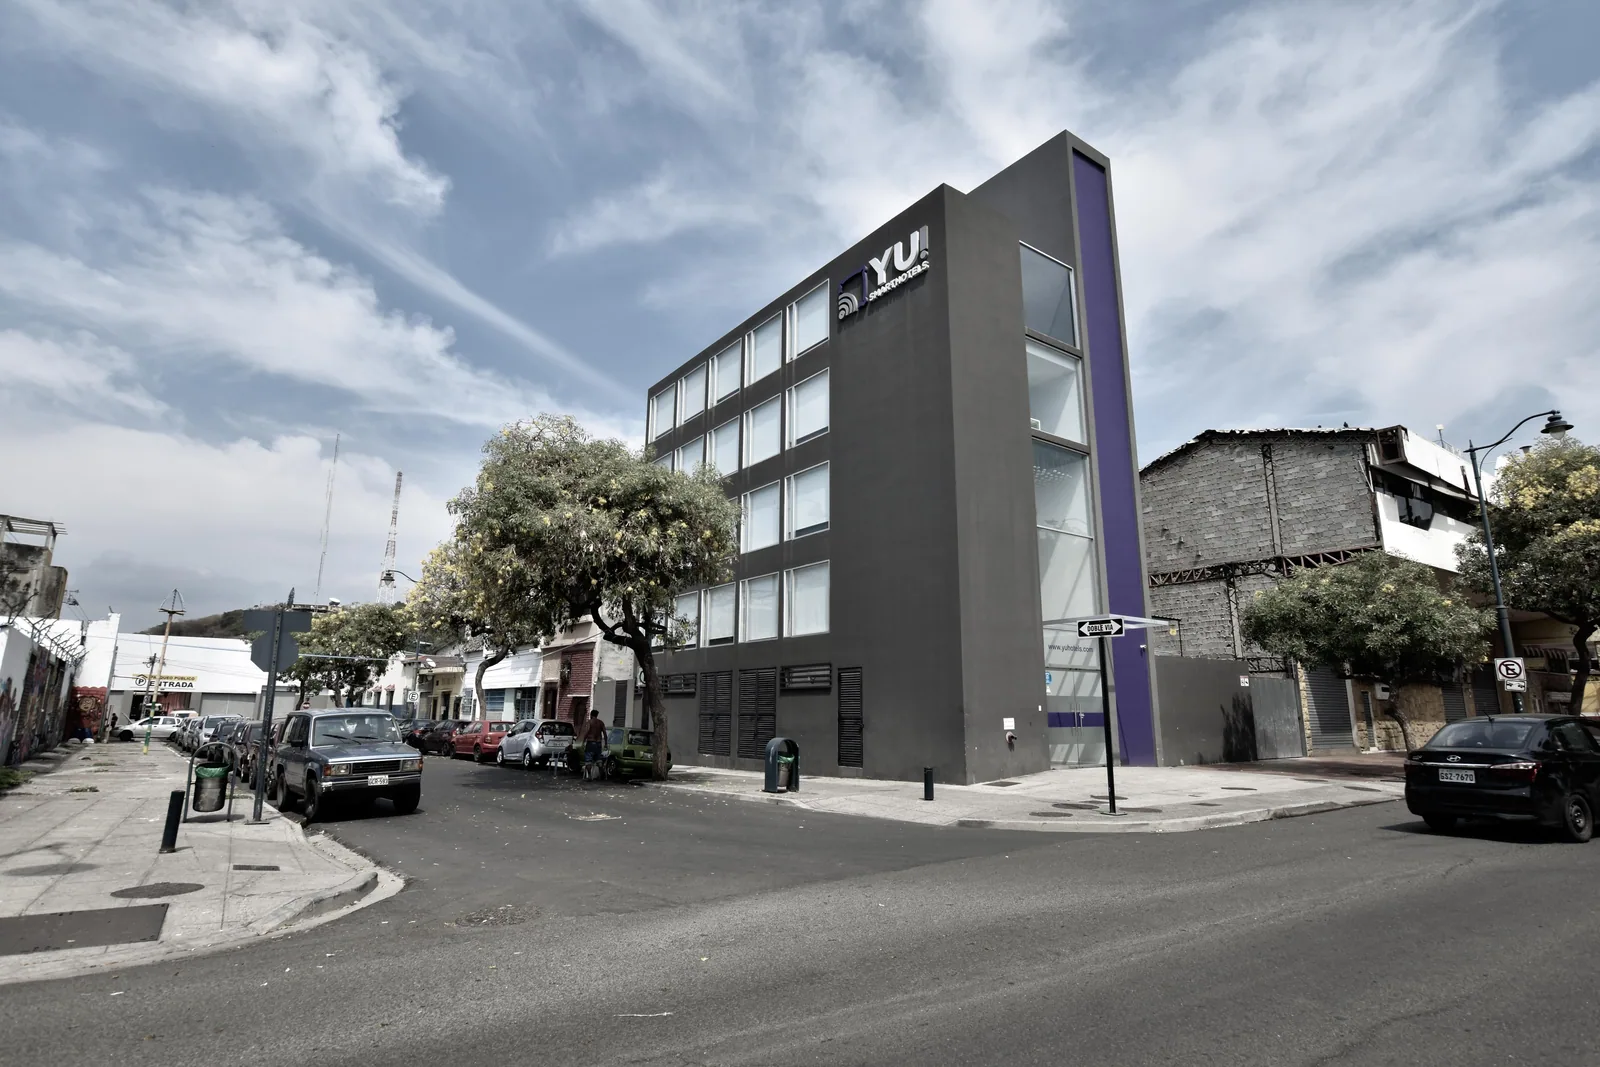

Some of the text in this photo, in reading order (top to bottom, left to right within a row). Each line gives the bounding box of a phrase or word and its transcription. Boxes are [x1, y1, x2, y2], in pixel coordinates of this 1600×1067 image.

[868, 225, 928, 286] YU!
[869, 260, 930, 301] SMARTHOTELS
[1087, 624, 1104, 632] DOBLE
[1048, 644, 1094, 653] www.yuhotels.com
[1440, 772, 1474, 781] GSZ-7670
